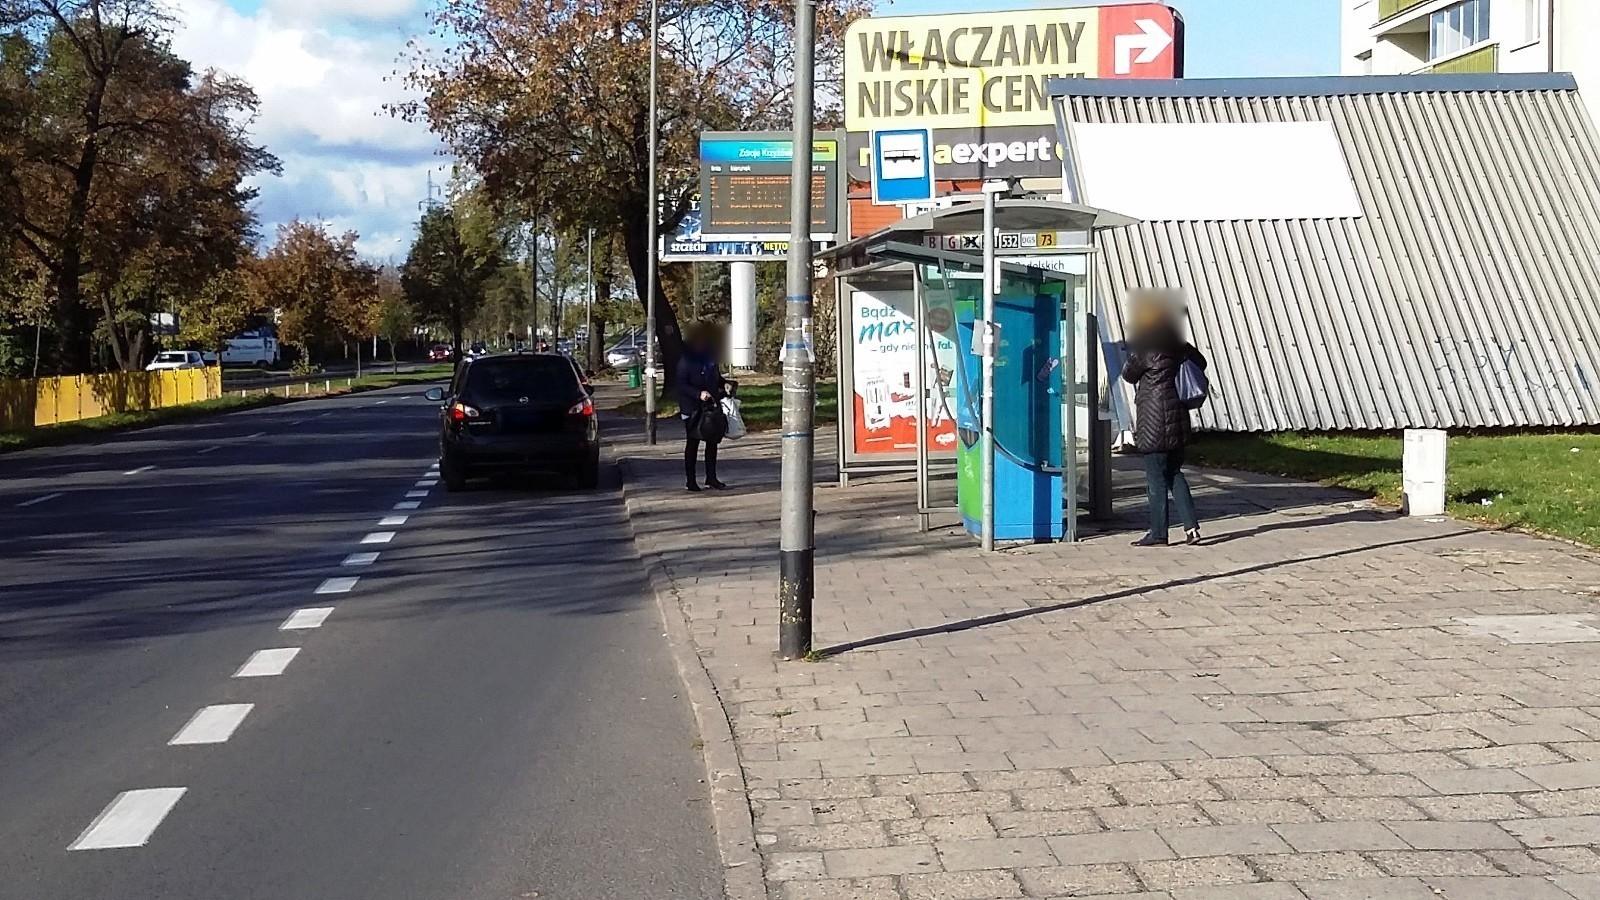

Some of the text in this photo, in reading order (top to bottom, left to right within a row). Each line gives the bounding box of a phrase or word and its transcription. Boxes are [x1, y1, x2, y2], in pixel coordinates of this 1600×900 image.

[858, 22, 1086, 73] WŁĄCZAMY
[858, 77, 970, 118] NISKIE
[670, 241, 707, 252] SZCZECIN
[763, 242, 788, 251] NETTO
[928, 236, 936, 249] B
[948, 236, 956, 249] G
[1001, 235, 1018, 248] 532
[1040, 234, 1053, 246] 73
[861, 304, 896, 321] Bądź
